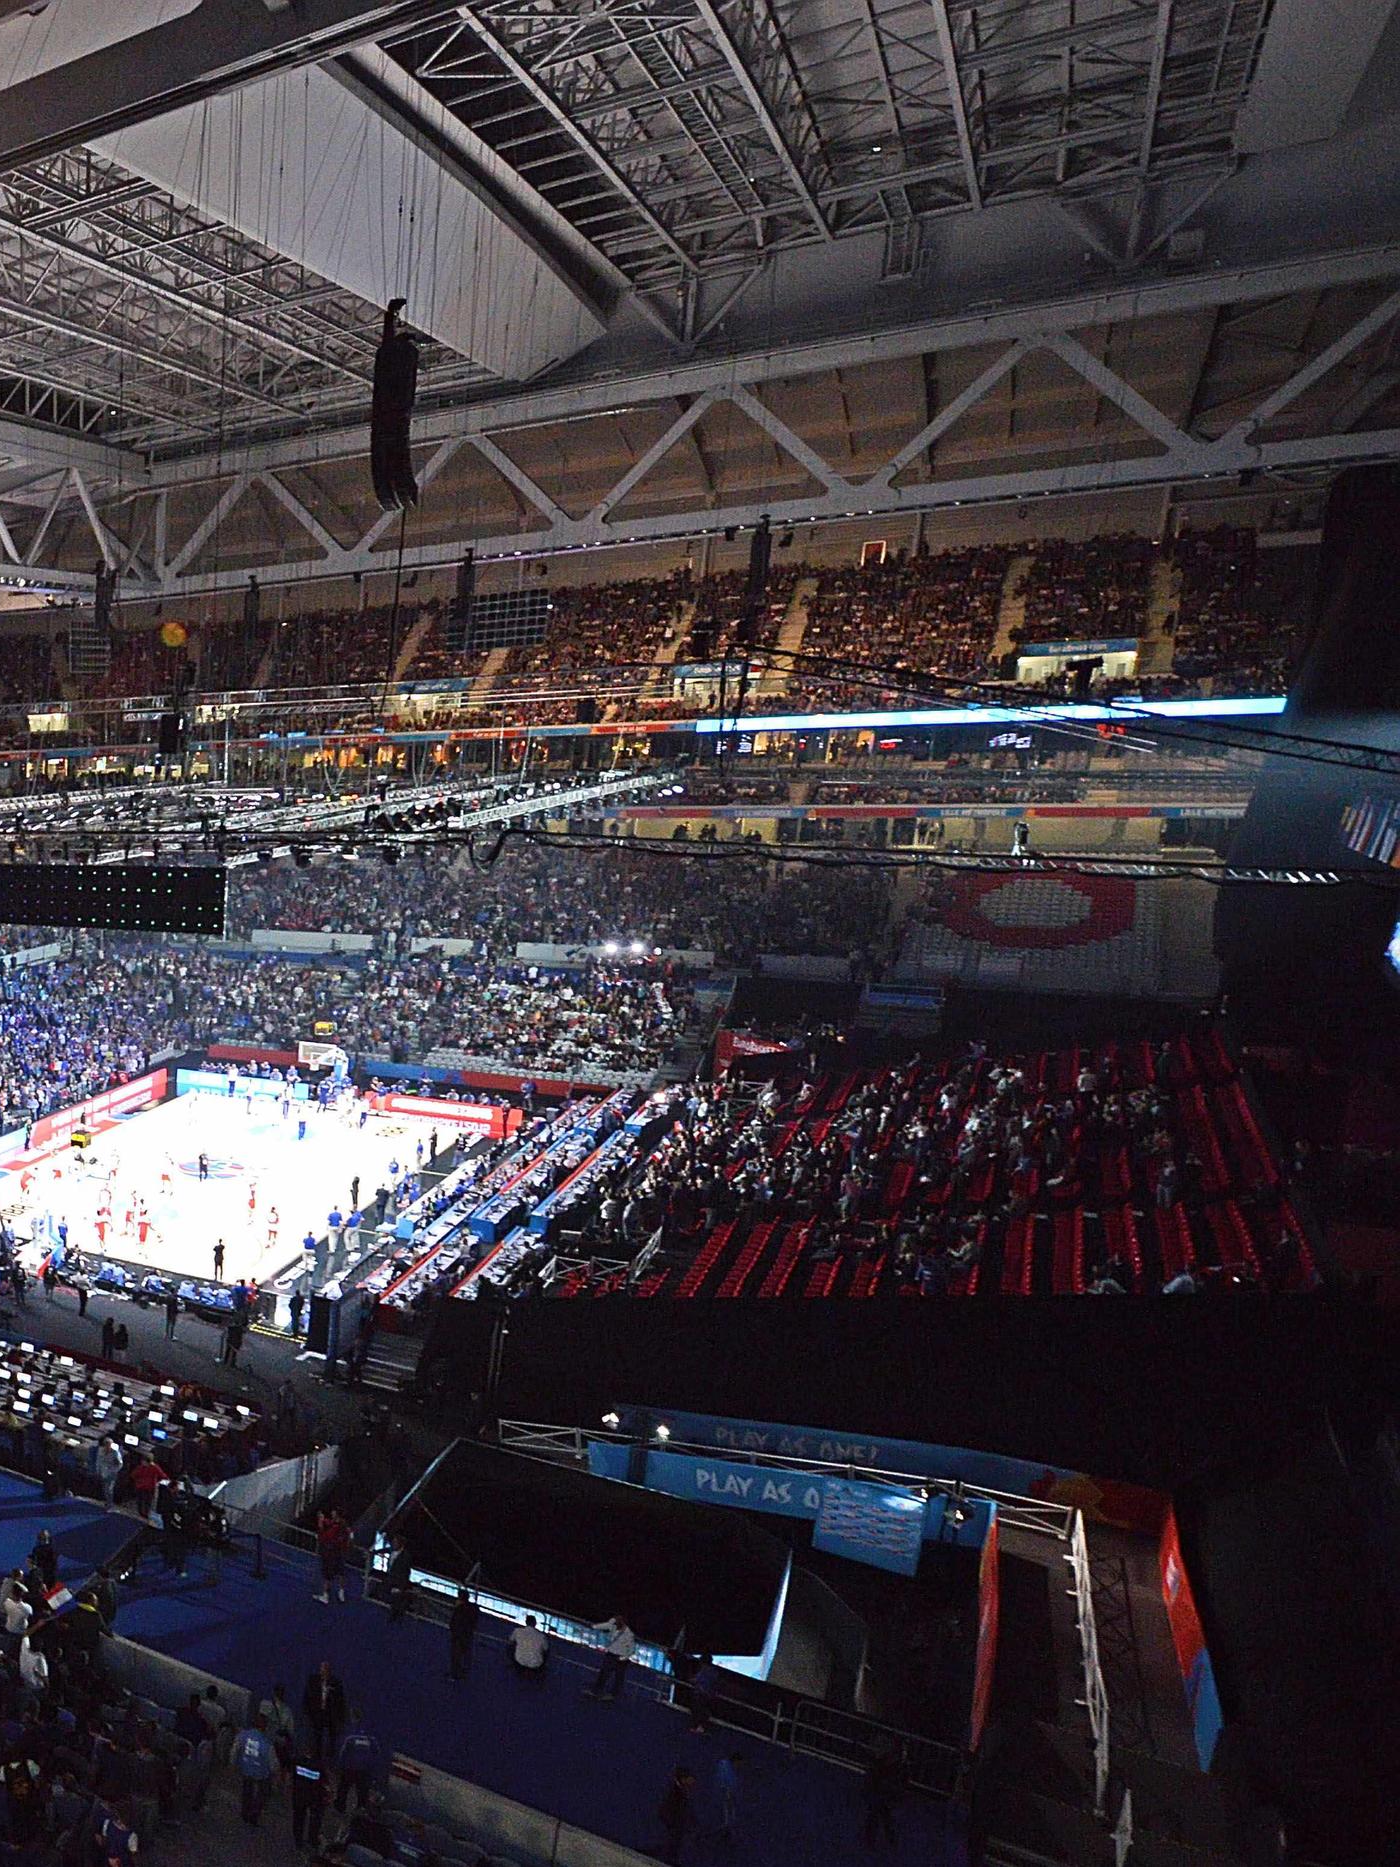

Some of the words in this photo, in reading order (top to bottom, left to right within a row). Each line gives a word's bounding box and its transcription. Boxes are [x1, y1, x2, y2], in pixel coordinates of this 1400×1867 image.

[716, 1426, 769, 1448] PLAY
[780, 1434, 811, 1455] AS
[696, 1468, 753, 1498] PLAY
[763, 1479, 792, 1504] AS
